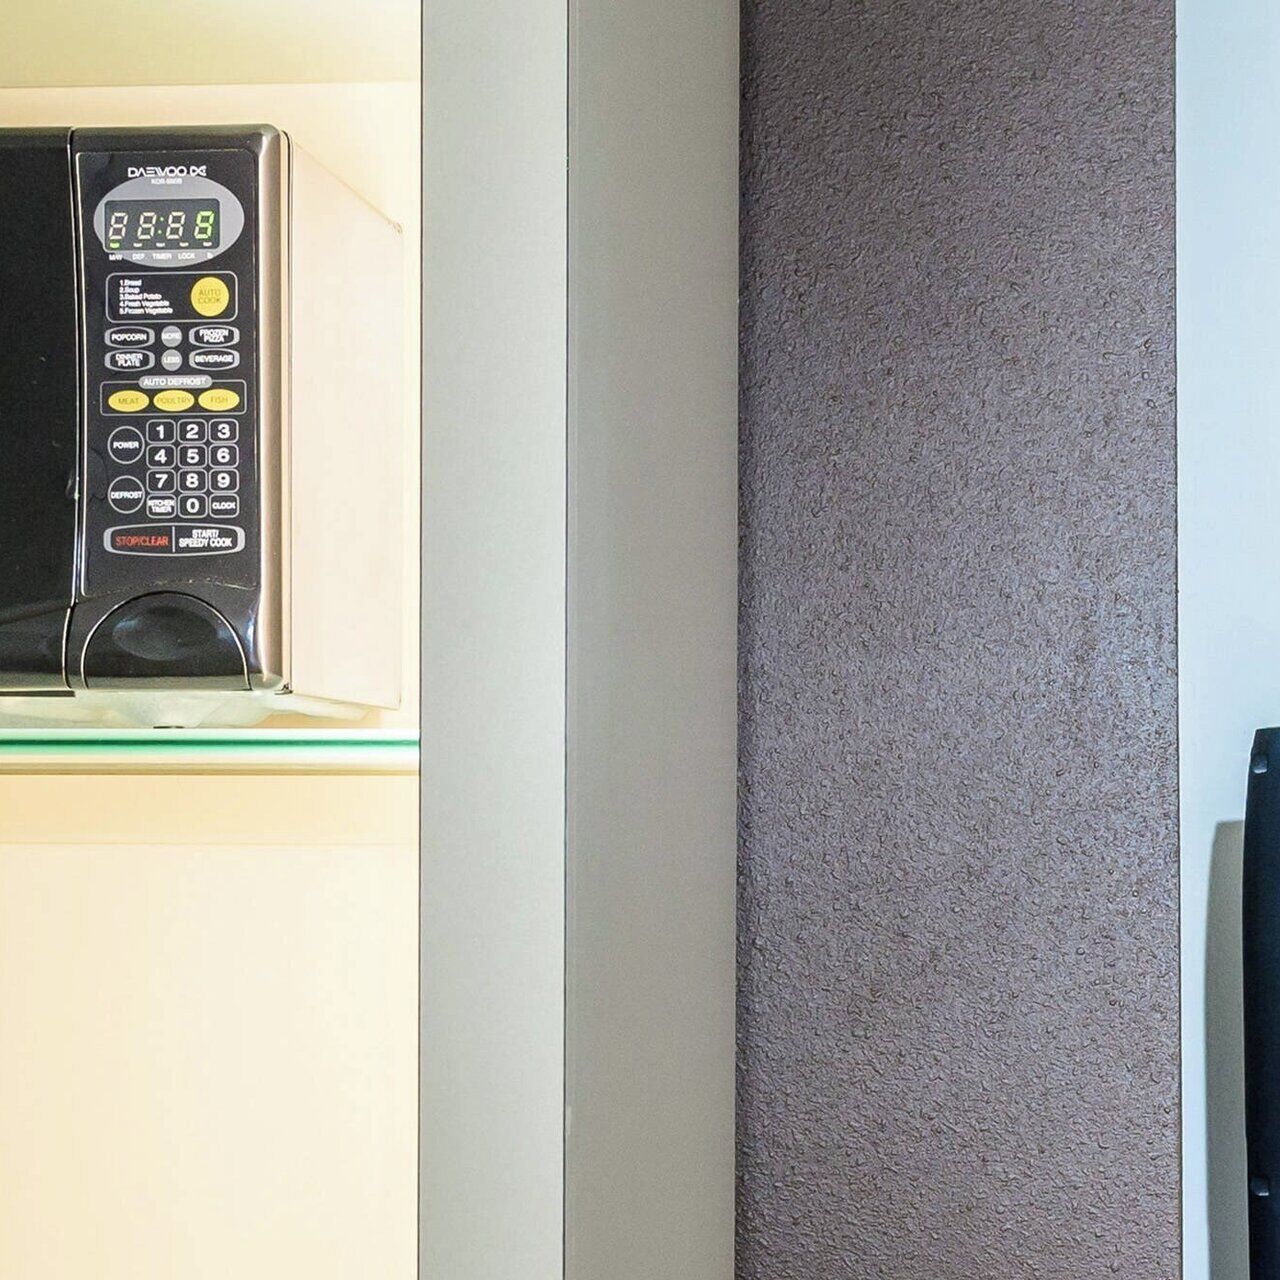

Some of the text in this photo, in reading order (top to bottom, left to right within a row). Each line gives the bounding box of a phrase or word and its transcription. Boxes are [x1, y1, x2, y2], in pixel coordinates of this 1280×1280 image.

[128, 166, 187, 177] DAEWOO
[111, 333, 147, 341] POPCORN
[195, 355, 233, 363] BEVERAGE
[143, 375, 206, 386] AUTO DEFROST
[156, 425, 165, 439] 1
[186, 424, 199, 439] 2
[217, 424, 231, 439] 3
[113, 441, 139, 449] POWER
[154, 450, 168, 464] 4
[186, 450, 199, 464] 5
[217, 449, 231, 463] 6
[155, 474, 168, 489] 7
[186, 474, 199, 488] 8
[217, 473, 231, 488] 9
[111, 491, 142, 499] DEFROST
[186, 498, 199, 513] 0
[212, 502, 236, 510] CLOCK
[116, 535, 169, 547] STOP/CLEAR
[179, 537, 232, 548] SPEEDY COOK
